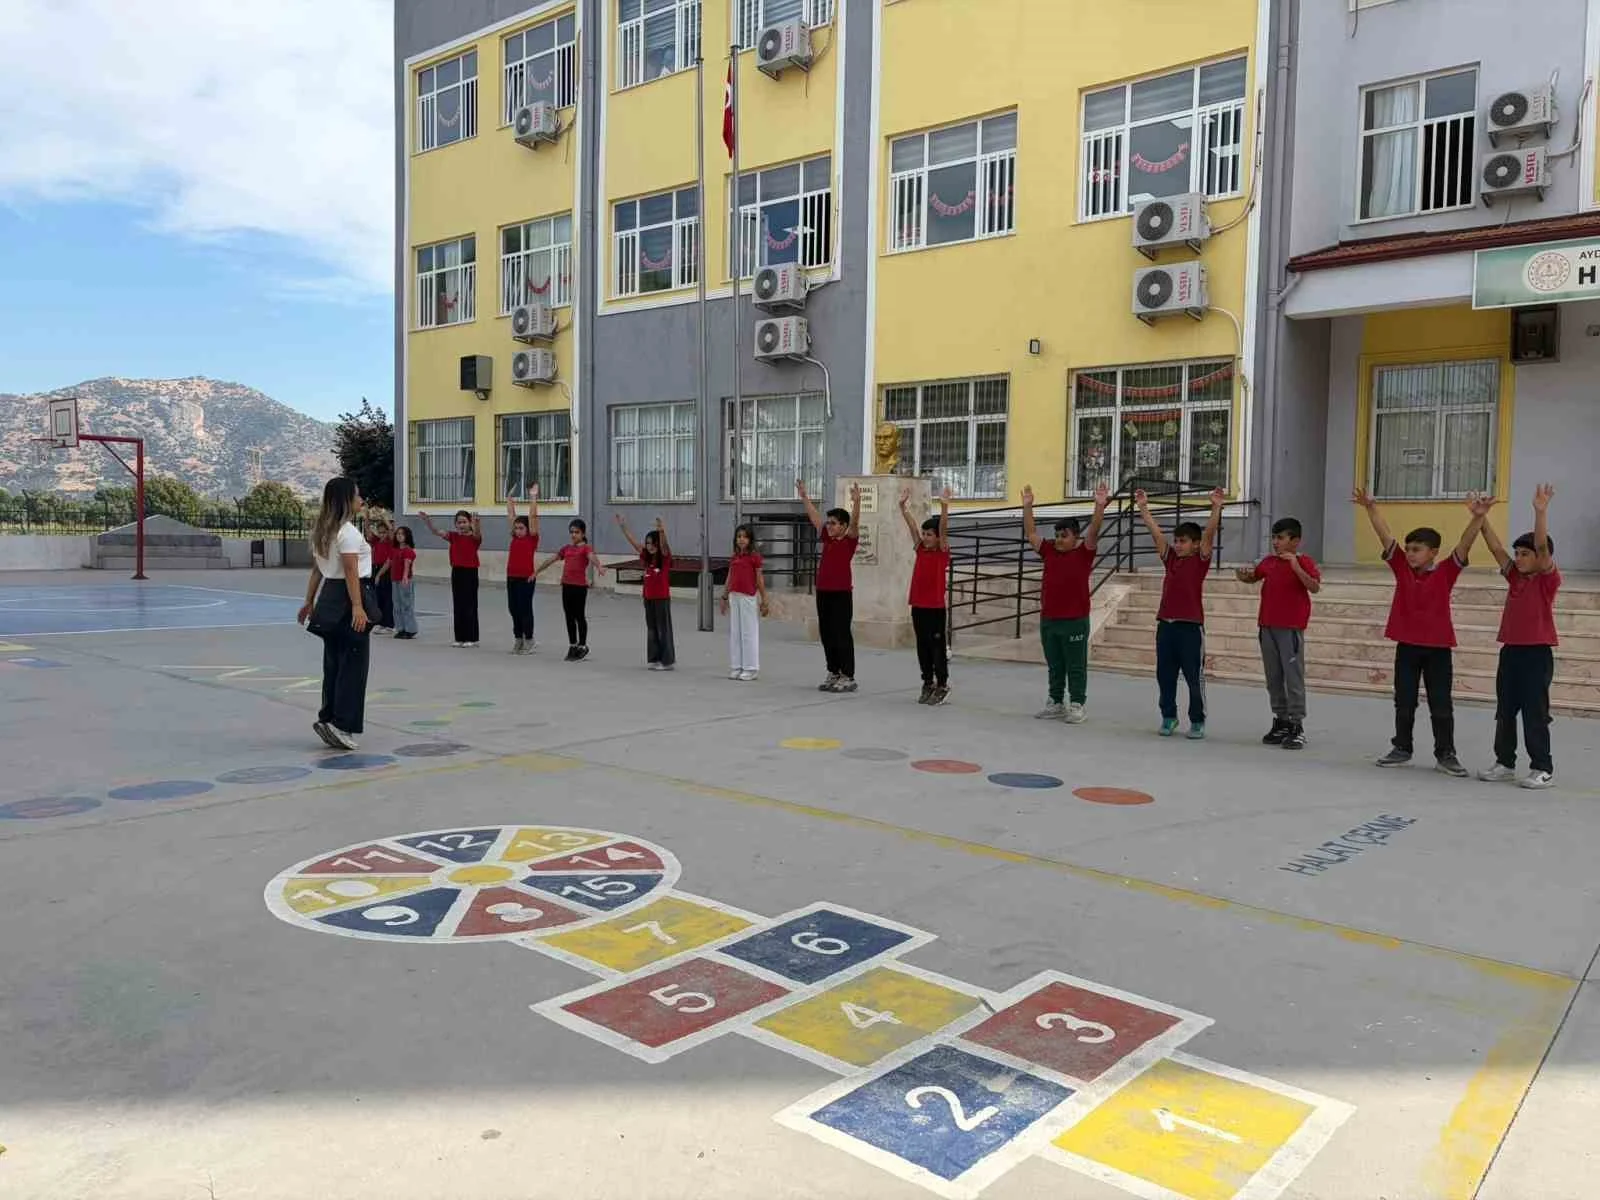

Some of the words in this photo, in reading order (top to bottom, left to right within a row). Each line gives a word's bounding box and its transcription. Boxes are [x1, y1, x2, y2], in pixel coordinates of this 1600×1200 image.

[1525, 152, 1536, 184] VESTEL
[1179, 202, 1189, 232] VESTEL
[1179, 272, 1189, 304] VESTEL
[416, 833, 491, 853] 12
[516, 833, 588, 852] 13
[331, 850, 406, 871] 11
[569, 847, 644, 868] 14
[1279, 840, 1364, 876] HALAT
[293, 880, 379, 905] 10
[561, 876, 636, 900] 15
[361, 904, 420, 926] 9
[486, 902, 544, 923] 8
[622, 919, 678, 945] 7
[792, 931, 851, 955] 6
[648, 983, 716, 1013] 5
[840, 1002, 902, 1029] 4
[1035, 1012, 1116, 1044] 3
[904, 1085, 1000, 1132] 2
[1152, 1108, 1242, 1144] 1
